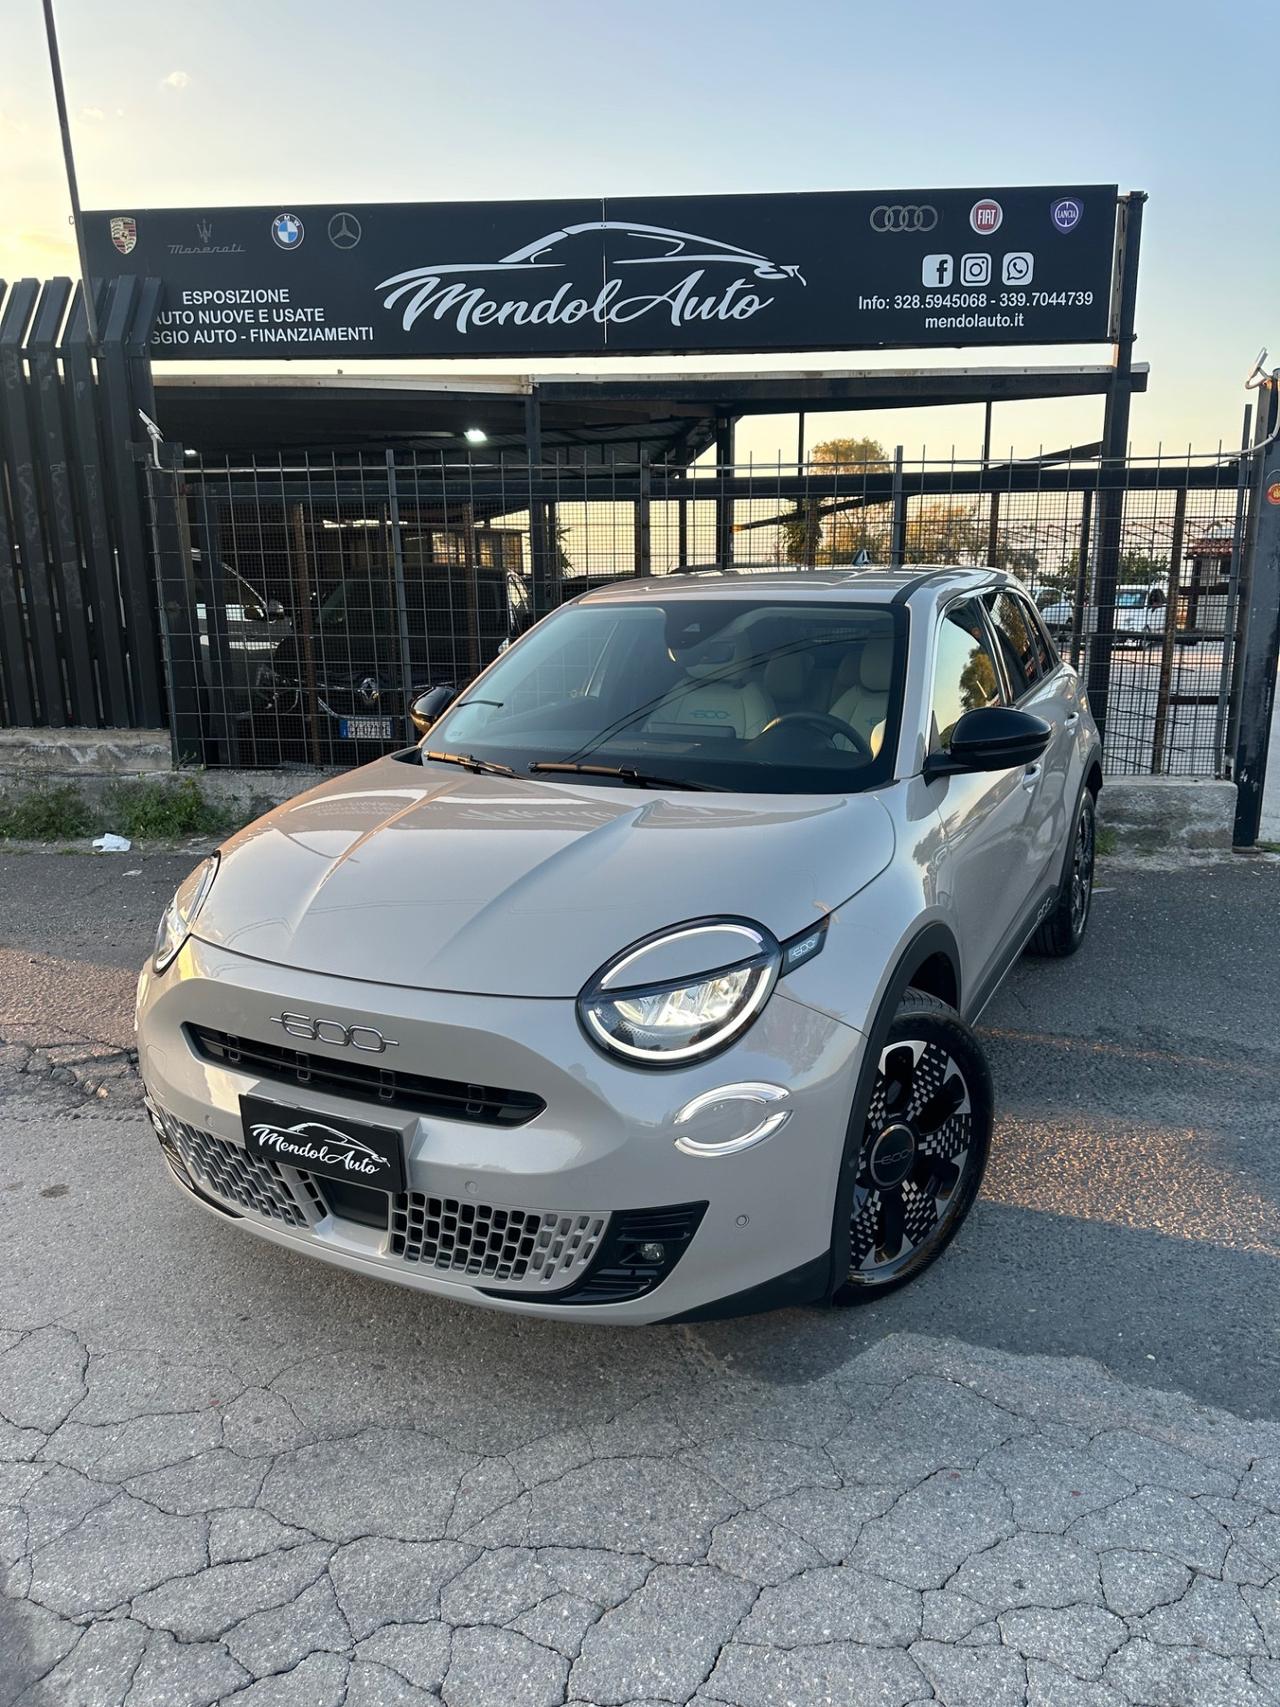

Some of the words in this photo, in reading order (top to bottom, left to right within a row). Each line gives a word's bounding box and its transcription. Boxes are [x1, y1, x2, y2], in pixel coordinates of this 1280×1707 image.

[977, 208, 996, 226] FIAT
[1057, 209, 1077, 220] LANCIA
[168, 243, 247, 255] Maserati
[182, 289, 290, 305] ESPOSIZIONE
[858, 295, 890, 310] Info:
[894, 293, 987, 309] 328.5945068
[999, 291, 1094, 307] 339.7044739
[198, 309, 254, 324] NUOVE
[258, 309, 269, 323] E
[273, 308, 325, 323] USATE
[925, 312, 1024, 329] mendolauto.it
[193, 329, 237, 344] AUTO
[250, 326, 374, 342] FINANZIAMENTI
